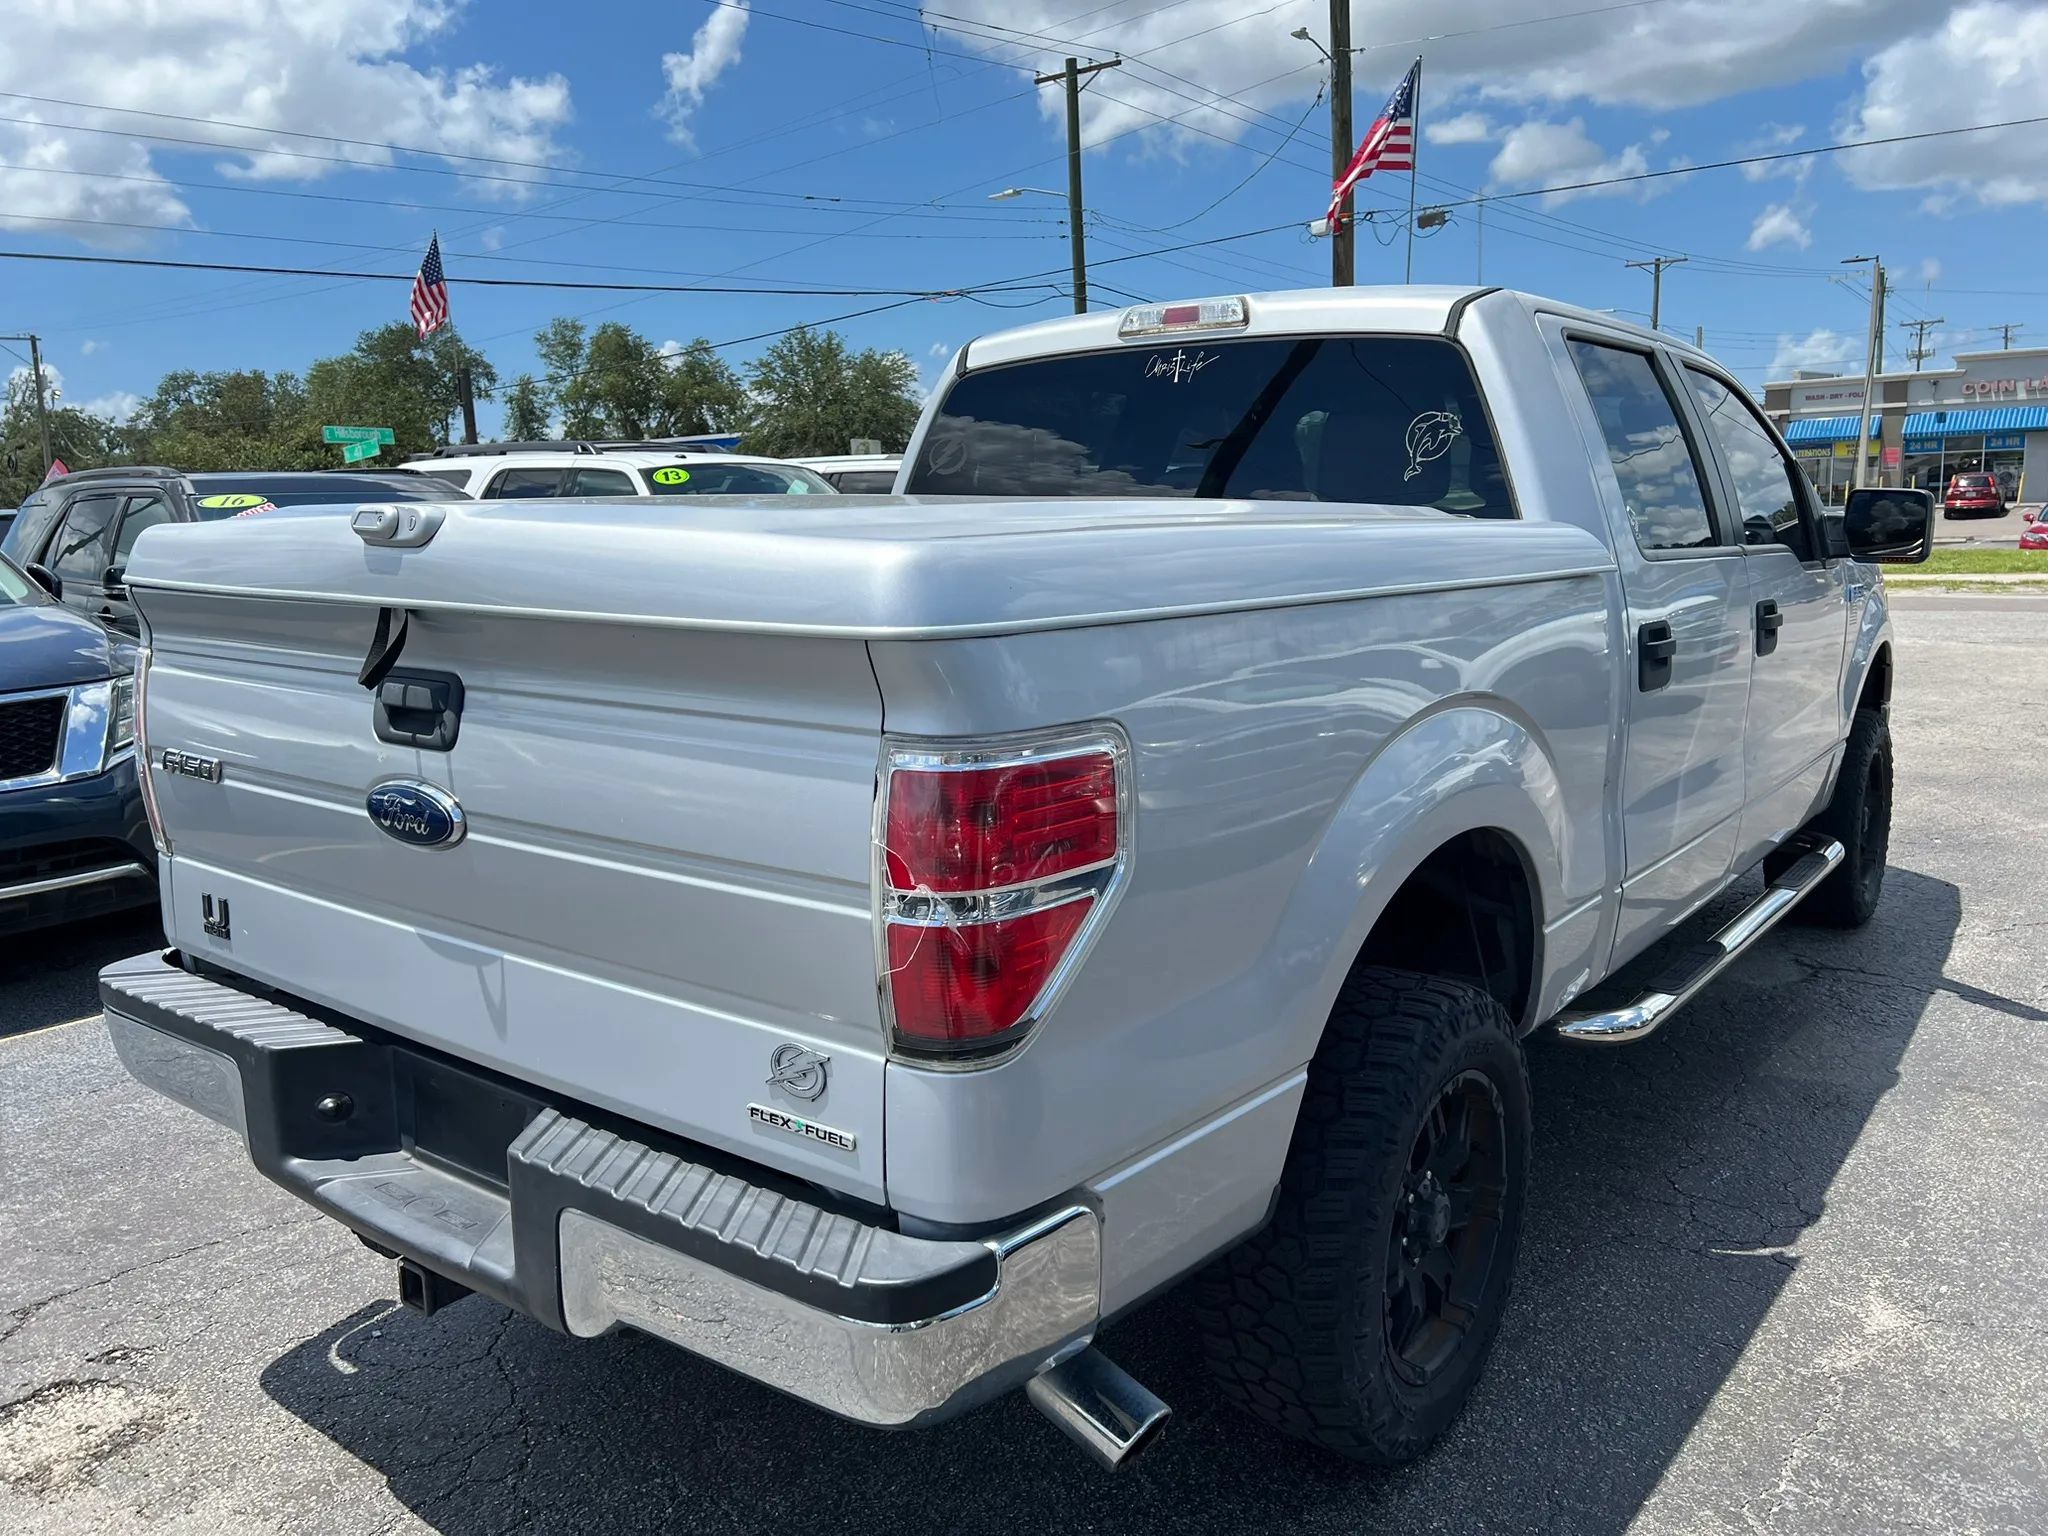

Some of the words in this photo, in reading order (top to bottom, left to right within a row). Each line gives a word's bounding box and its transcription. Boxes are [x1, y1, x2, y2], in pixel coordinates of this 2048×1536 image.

[1962, 379, 2015, 395] COIN
[1910, 442, 1921, 451] 24
[1924, 441, 1938, 449] HR
[2006, 435, 2020, 446] HR
[662, 470, 682, 482] 13
[219, 496, 245, 507] 16
[373, 792, 431, 836] Ford
[750, 1106, 792, 1130] FLEX
[805, 1124, 849, 1149] FUEL
